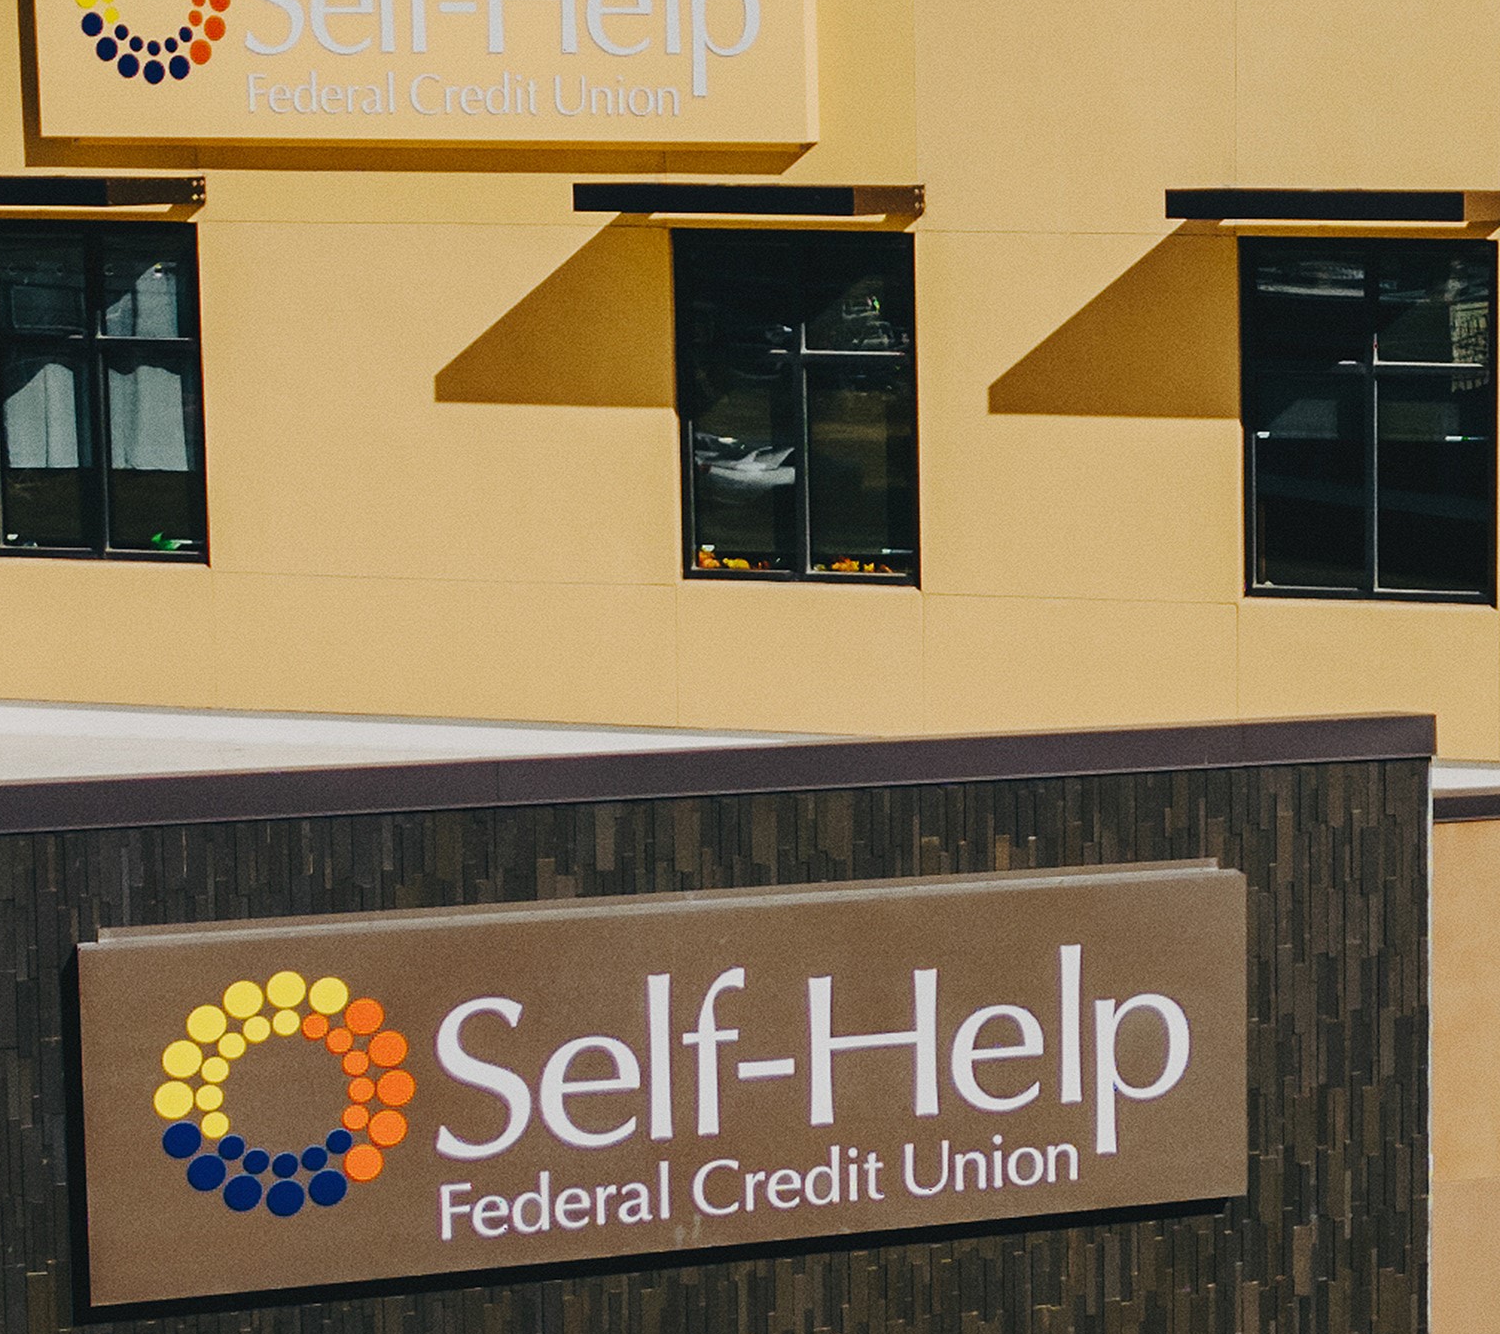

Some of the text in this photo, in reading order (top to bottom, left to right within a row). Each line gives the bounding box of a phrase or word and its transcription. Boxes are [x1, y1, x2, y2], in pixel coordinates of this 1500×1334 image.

[247, 71, 682, 116] Federal Credit Union
[436, 944, 1190, 1160] Self-Help
[439, 1134, 1080, 1240] Federal Credit Union
